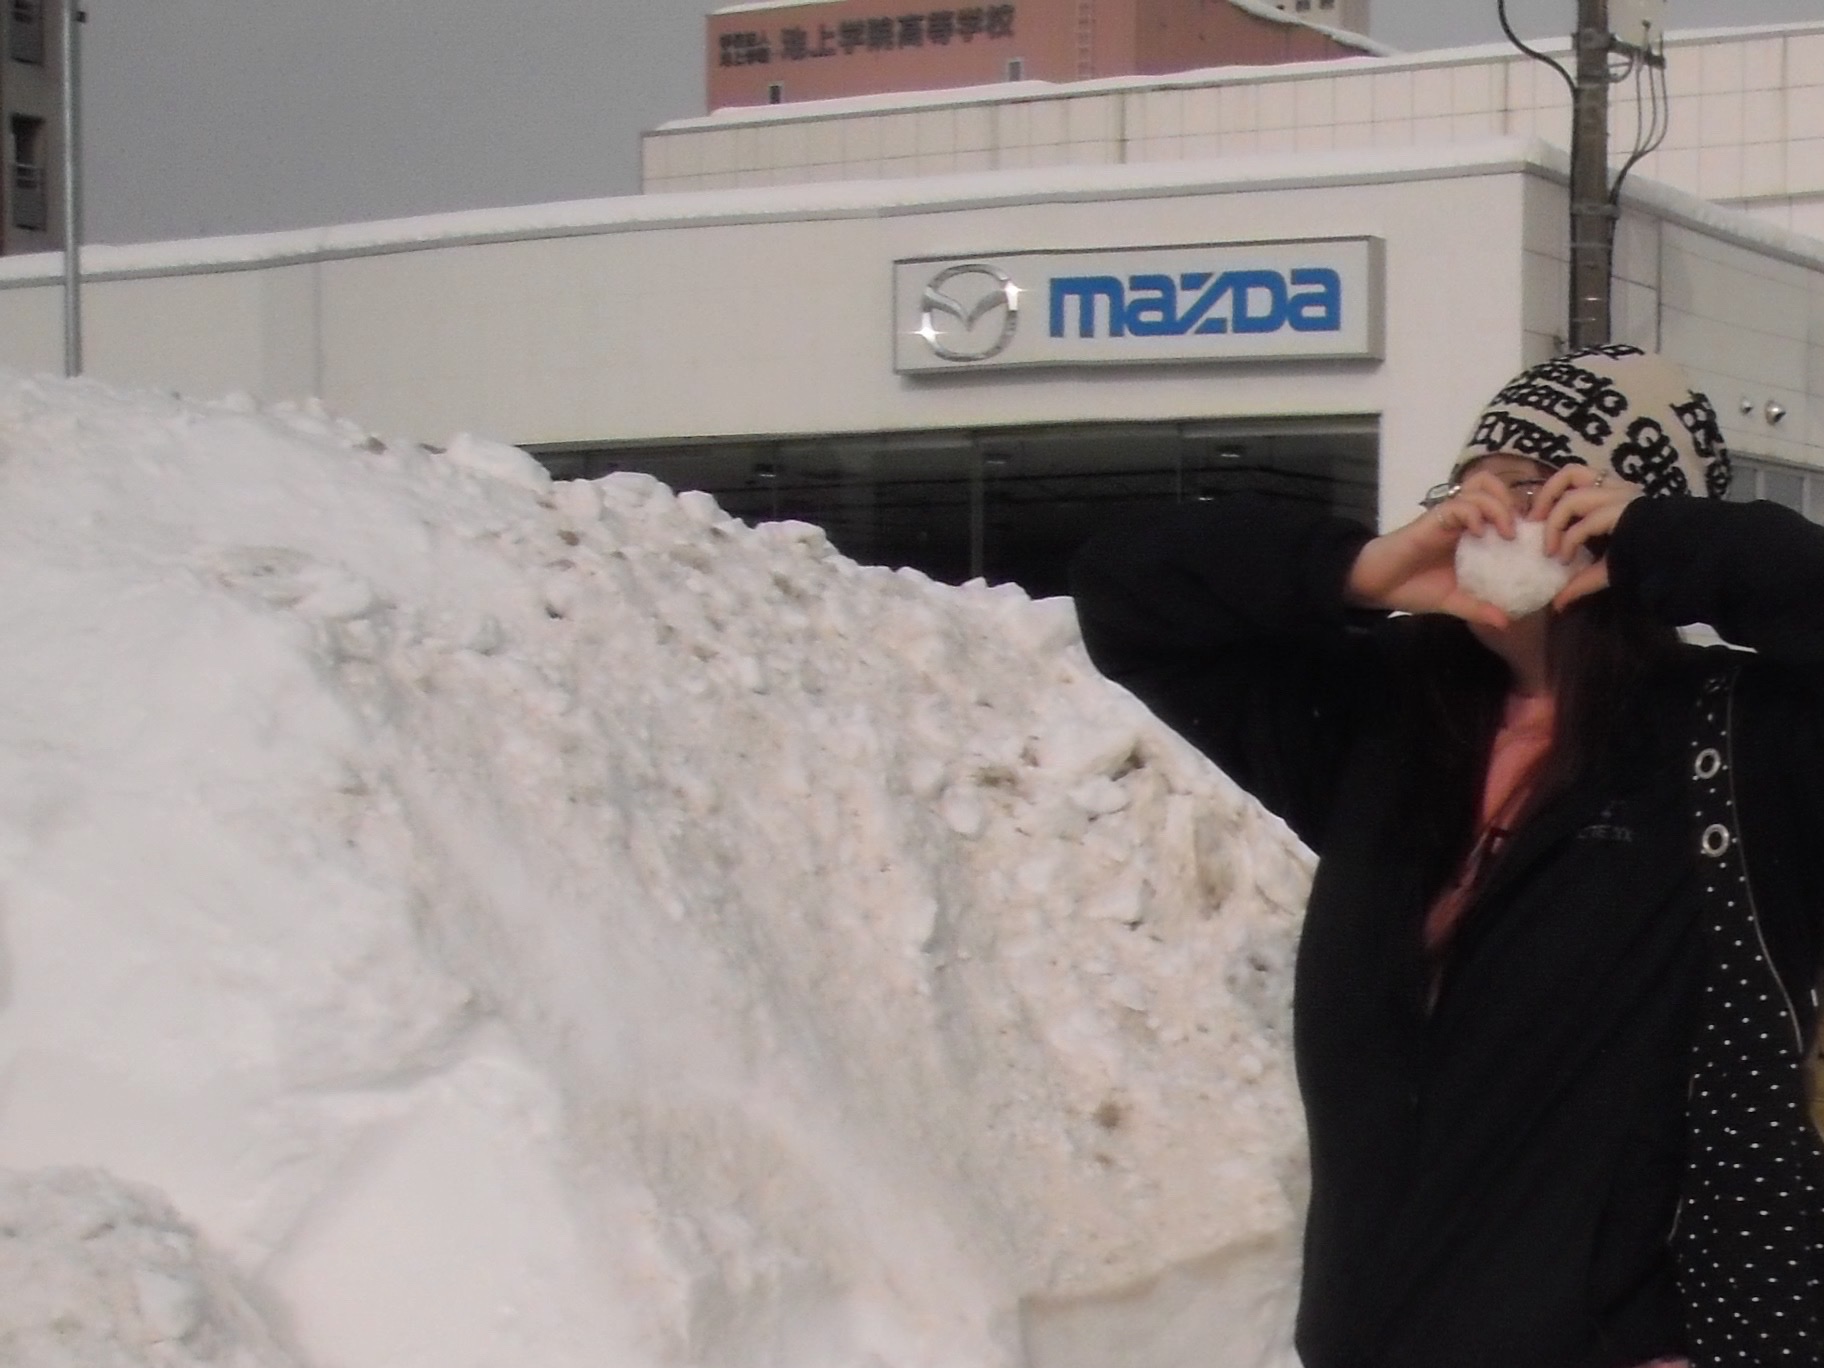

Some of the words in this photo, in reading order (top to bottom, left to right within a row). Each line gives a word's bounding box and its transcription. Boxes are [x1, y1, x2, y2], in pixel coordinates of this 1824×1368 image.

[780, 4, 1016, 61] 池上学院高等学校
